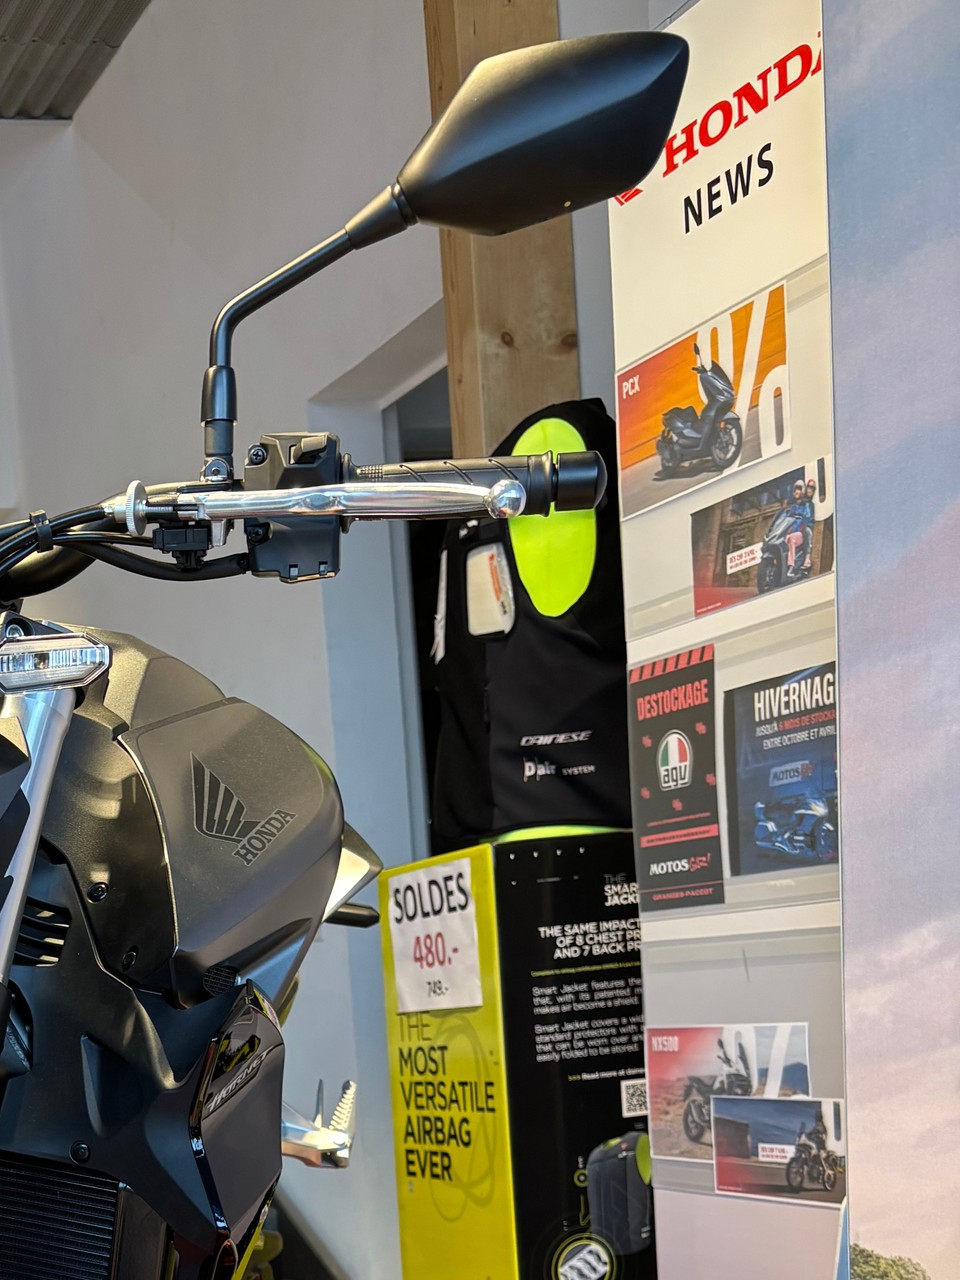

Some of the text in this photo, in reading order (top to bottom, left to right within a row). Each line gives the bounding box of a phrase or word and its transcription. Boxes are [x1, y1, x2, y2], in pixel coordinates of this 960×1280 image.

[682, 142, 775, 235] NEWS
[622, 374, 640, 399] PCX
[636, 679, 709, 721] DESTOCKAGE
[753, 672, 836, 722] HIVERNAG
[520, 730, 592, 746] DAINESE
[763, 736, 782, 750] ENTRE
[782, 730, 809, 746] OCTOBRE
[809, 728, 818, 740] ET
[561, 765, 595, 775] SYSTEM
[663, 764, 687, 788] agv
[233, 809, 297, 866] HONDA
[603, 872, 626, 884] THE
[604, 882, 639, 896] SMAR
[393, 872, 469, 924] SOLDES
[538, 925, 563, 938] THE
[564, 921, 598, 936] SAME
[556, 935, 574, 948] OF
[585, 930, 625, 945] CHEST
[413, 931, 459, 969] 480.-
[553, 946, 581, 959] AND
[581, 945, 590, 957] 7
[592, 941, 626, 956] BACK
[532, 986, 558, 996] Smart
[561, 983, 589, 993] Jacket
[591, 980, 625, 990] features
[573, 1000, 606, 1011] become
[397, 1011, 432, 1042] THE
[534, 1024, 560, 1034] Smart
[561, 1020, 589, 1031] Jacket
[535, 1031, 572, 1043] standard
[573, 1027, 617, 1040] protectors
[398, 1045, 448, 1077] MOST
[207, 1045, 274, 1112] HORNET
[399, 1081, 496, 1113] VERSATILE
[404, 1115, 472, 1148] AIRBAG
[405, 1149, 453, 1182] EVER
